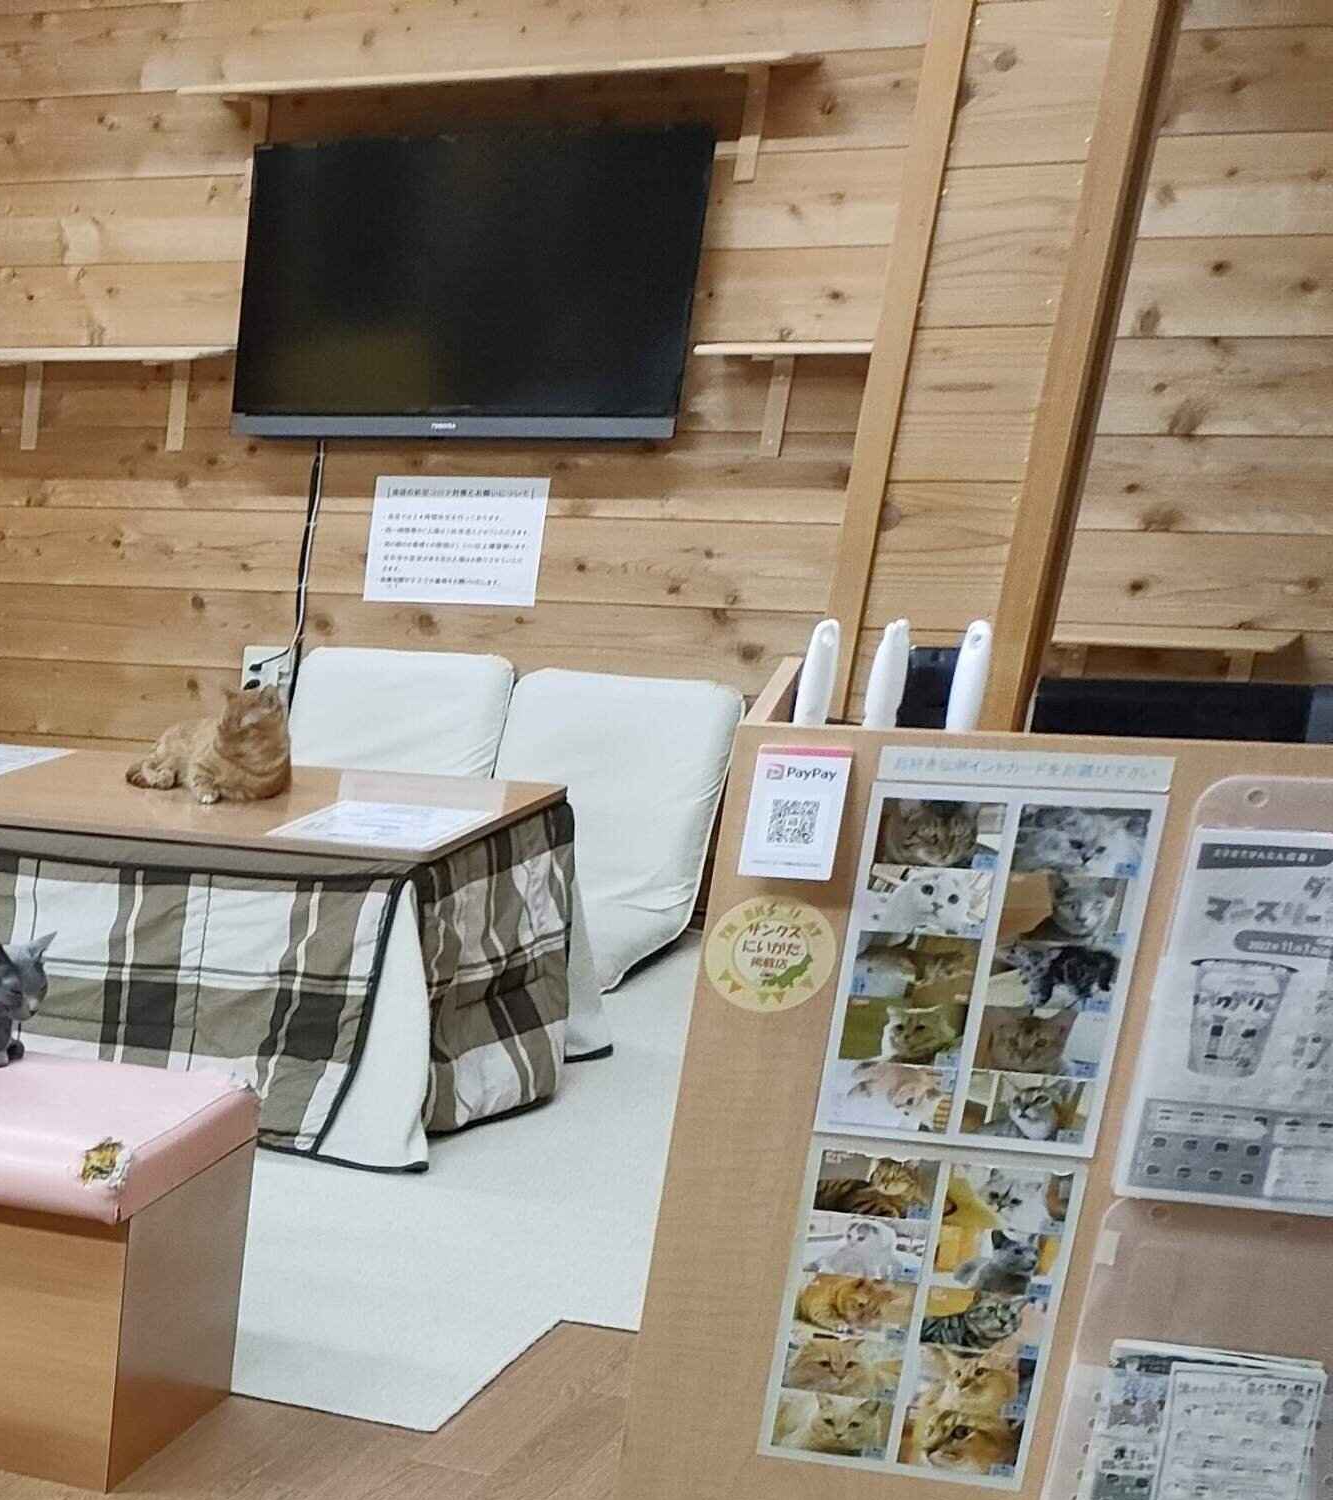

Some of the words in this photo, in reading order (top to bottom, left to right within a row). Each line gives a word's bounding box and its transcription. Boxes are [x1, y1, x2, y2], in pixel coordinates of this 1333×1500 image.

[786, 766, 838, 782] PayPay
[748, 923, 802, 939] サンクス
[742, 940, 804, 957] にいがた
